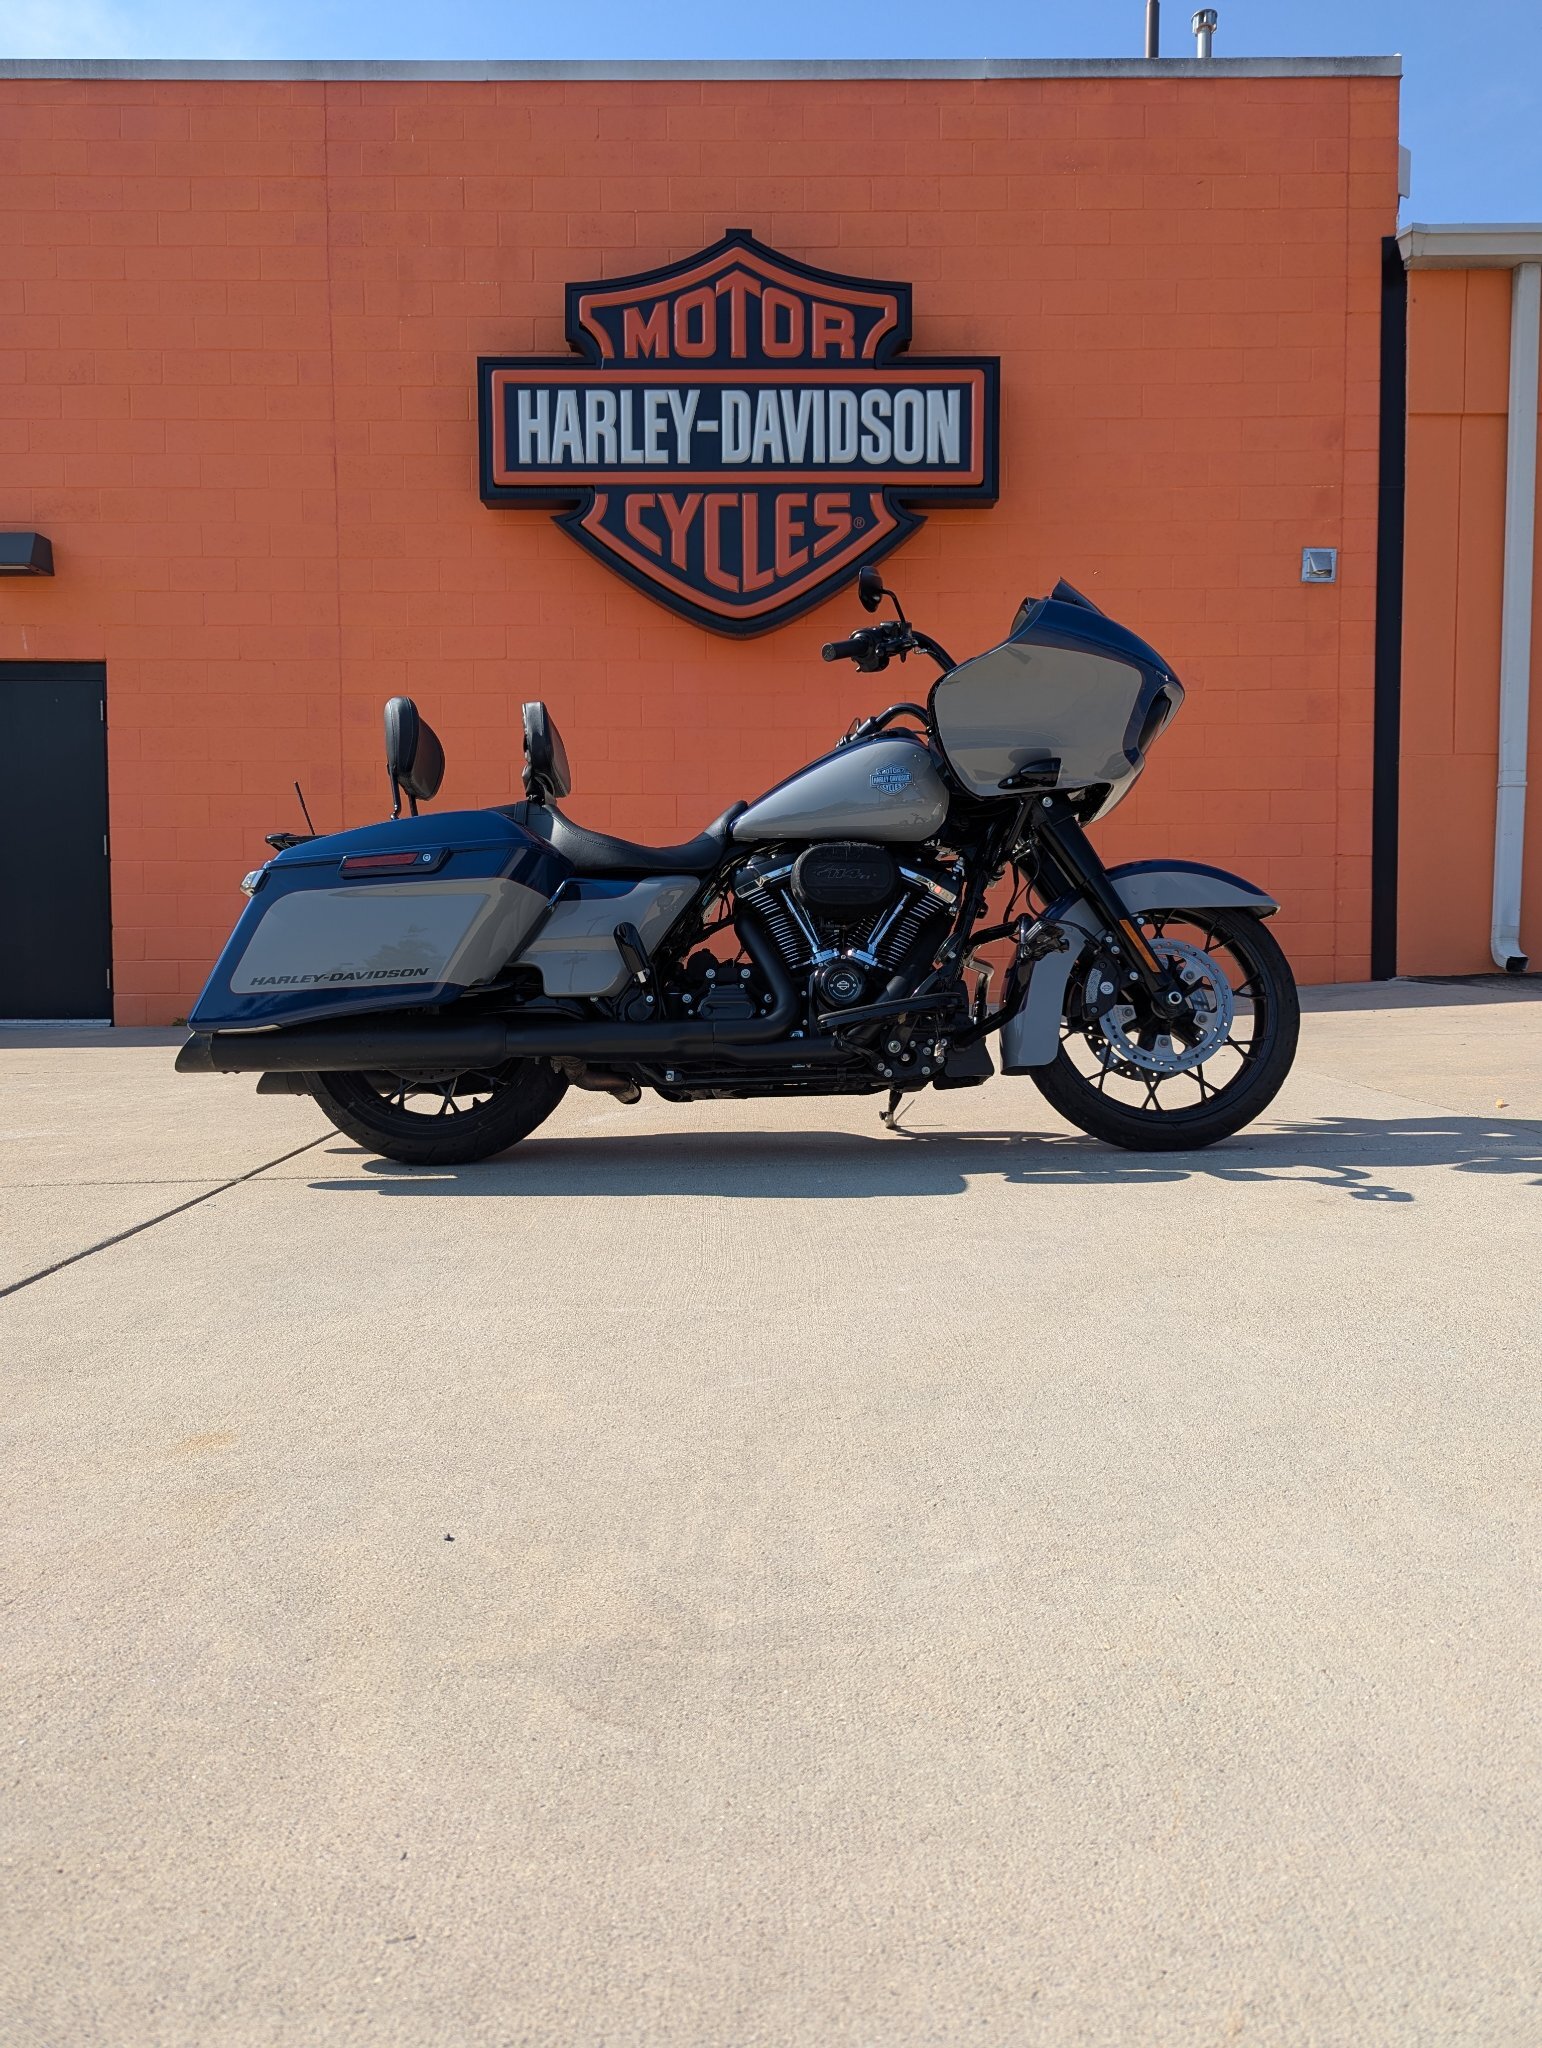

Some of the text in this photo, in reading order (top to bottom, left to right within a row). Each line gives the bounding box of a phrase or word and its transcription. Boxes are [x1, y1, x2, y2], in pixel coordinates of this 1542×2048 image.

[623, 269, 855, 359] MOTOR
[517, 388, 961, 465] HARLEY-DAVIDSON
[624, 492, 852, 593] CYCLES
[249, 967, 430, 986] HARLEY-DAVIDSON
